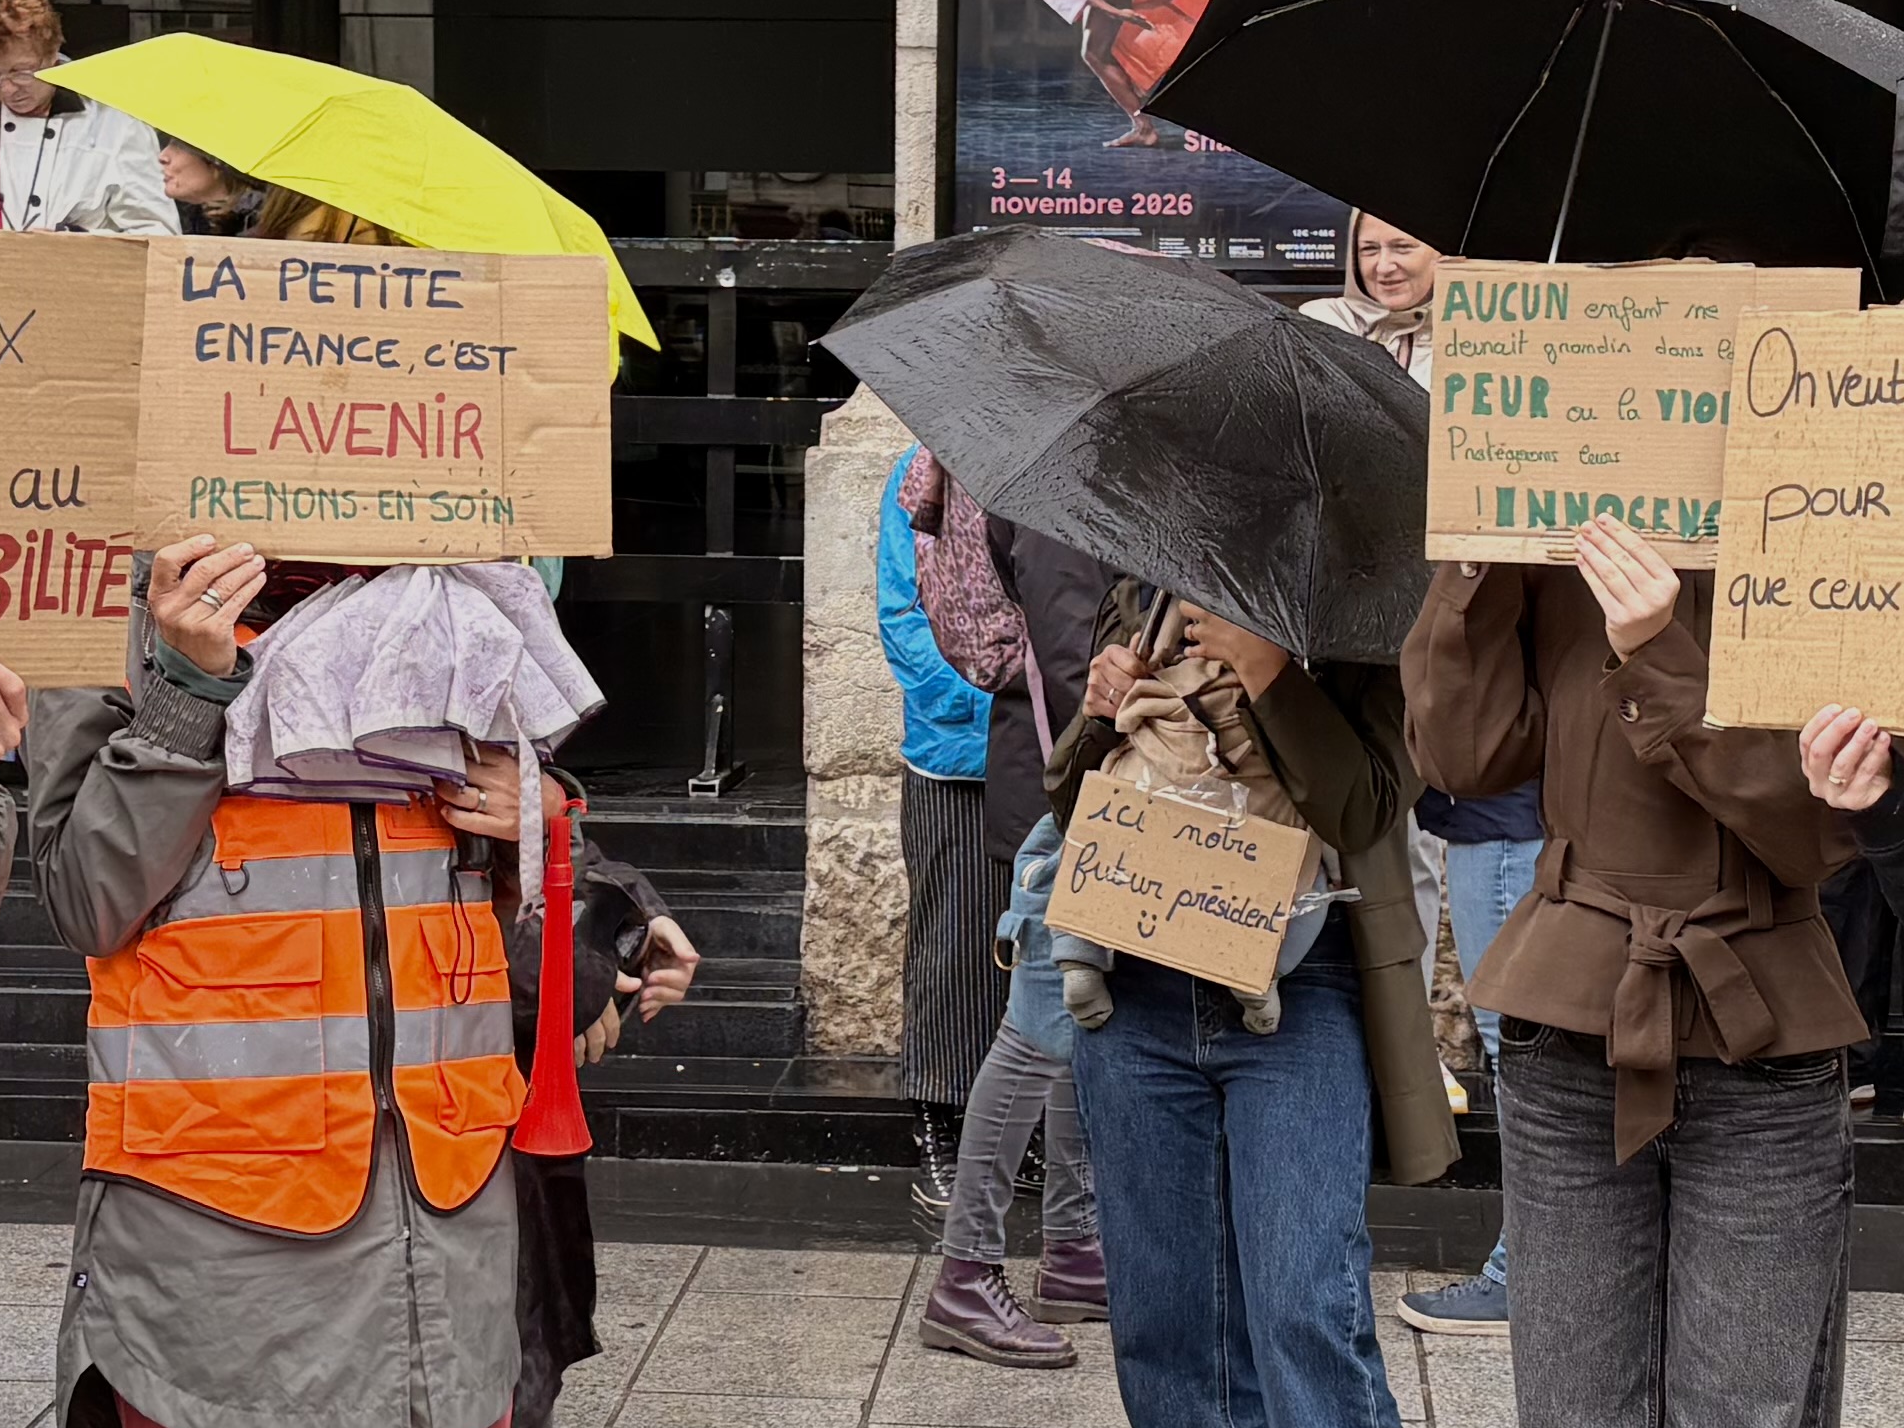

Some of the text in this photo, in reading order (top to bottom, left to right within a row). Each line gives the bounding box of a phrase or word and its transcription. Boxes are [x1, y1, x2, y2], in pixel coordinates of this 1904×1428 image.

[990, 192, 1195, 216] novembre 2026
[182, 255, 246, 302] LA
[1441, 281, 1721, 332] AUCUN enfant ne
[1655, 335, 1705, 360] dans
[1747, 327, 1817, 418] On
[1443, 372, 1551, 420] PEUR
[1566, 405, 1599, 423] ou
[1617, 386, 1642, 422] la
[8, 464, 87, 510] au
[377, 489, 416, 523] EN
[1728, 572, 1793, 640] que
[1808, 572, 1900, 613] ceux
[1087, 787, 1257, 862] ici notre
[1070, 841, 1286, 933] futur président
